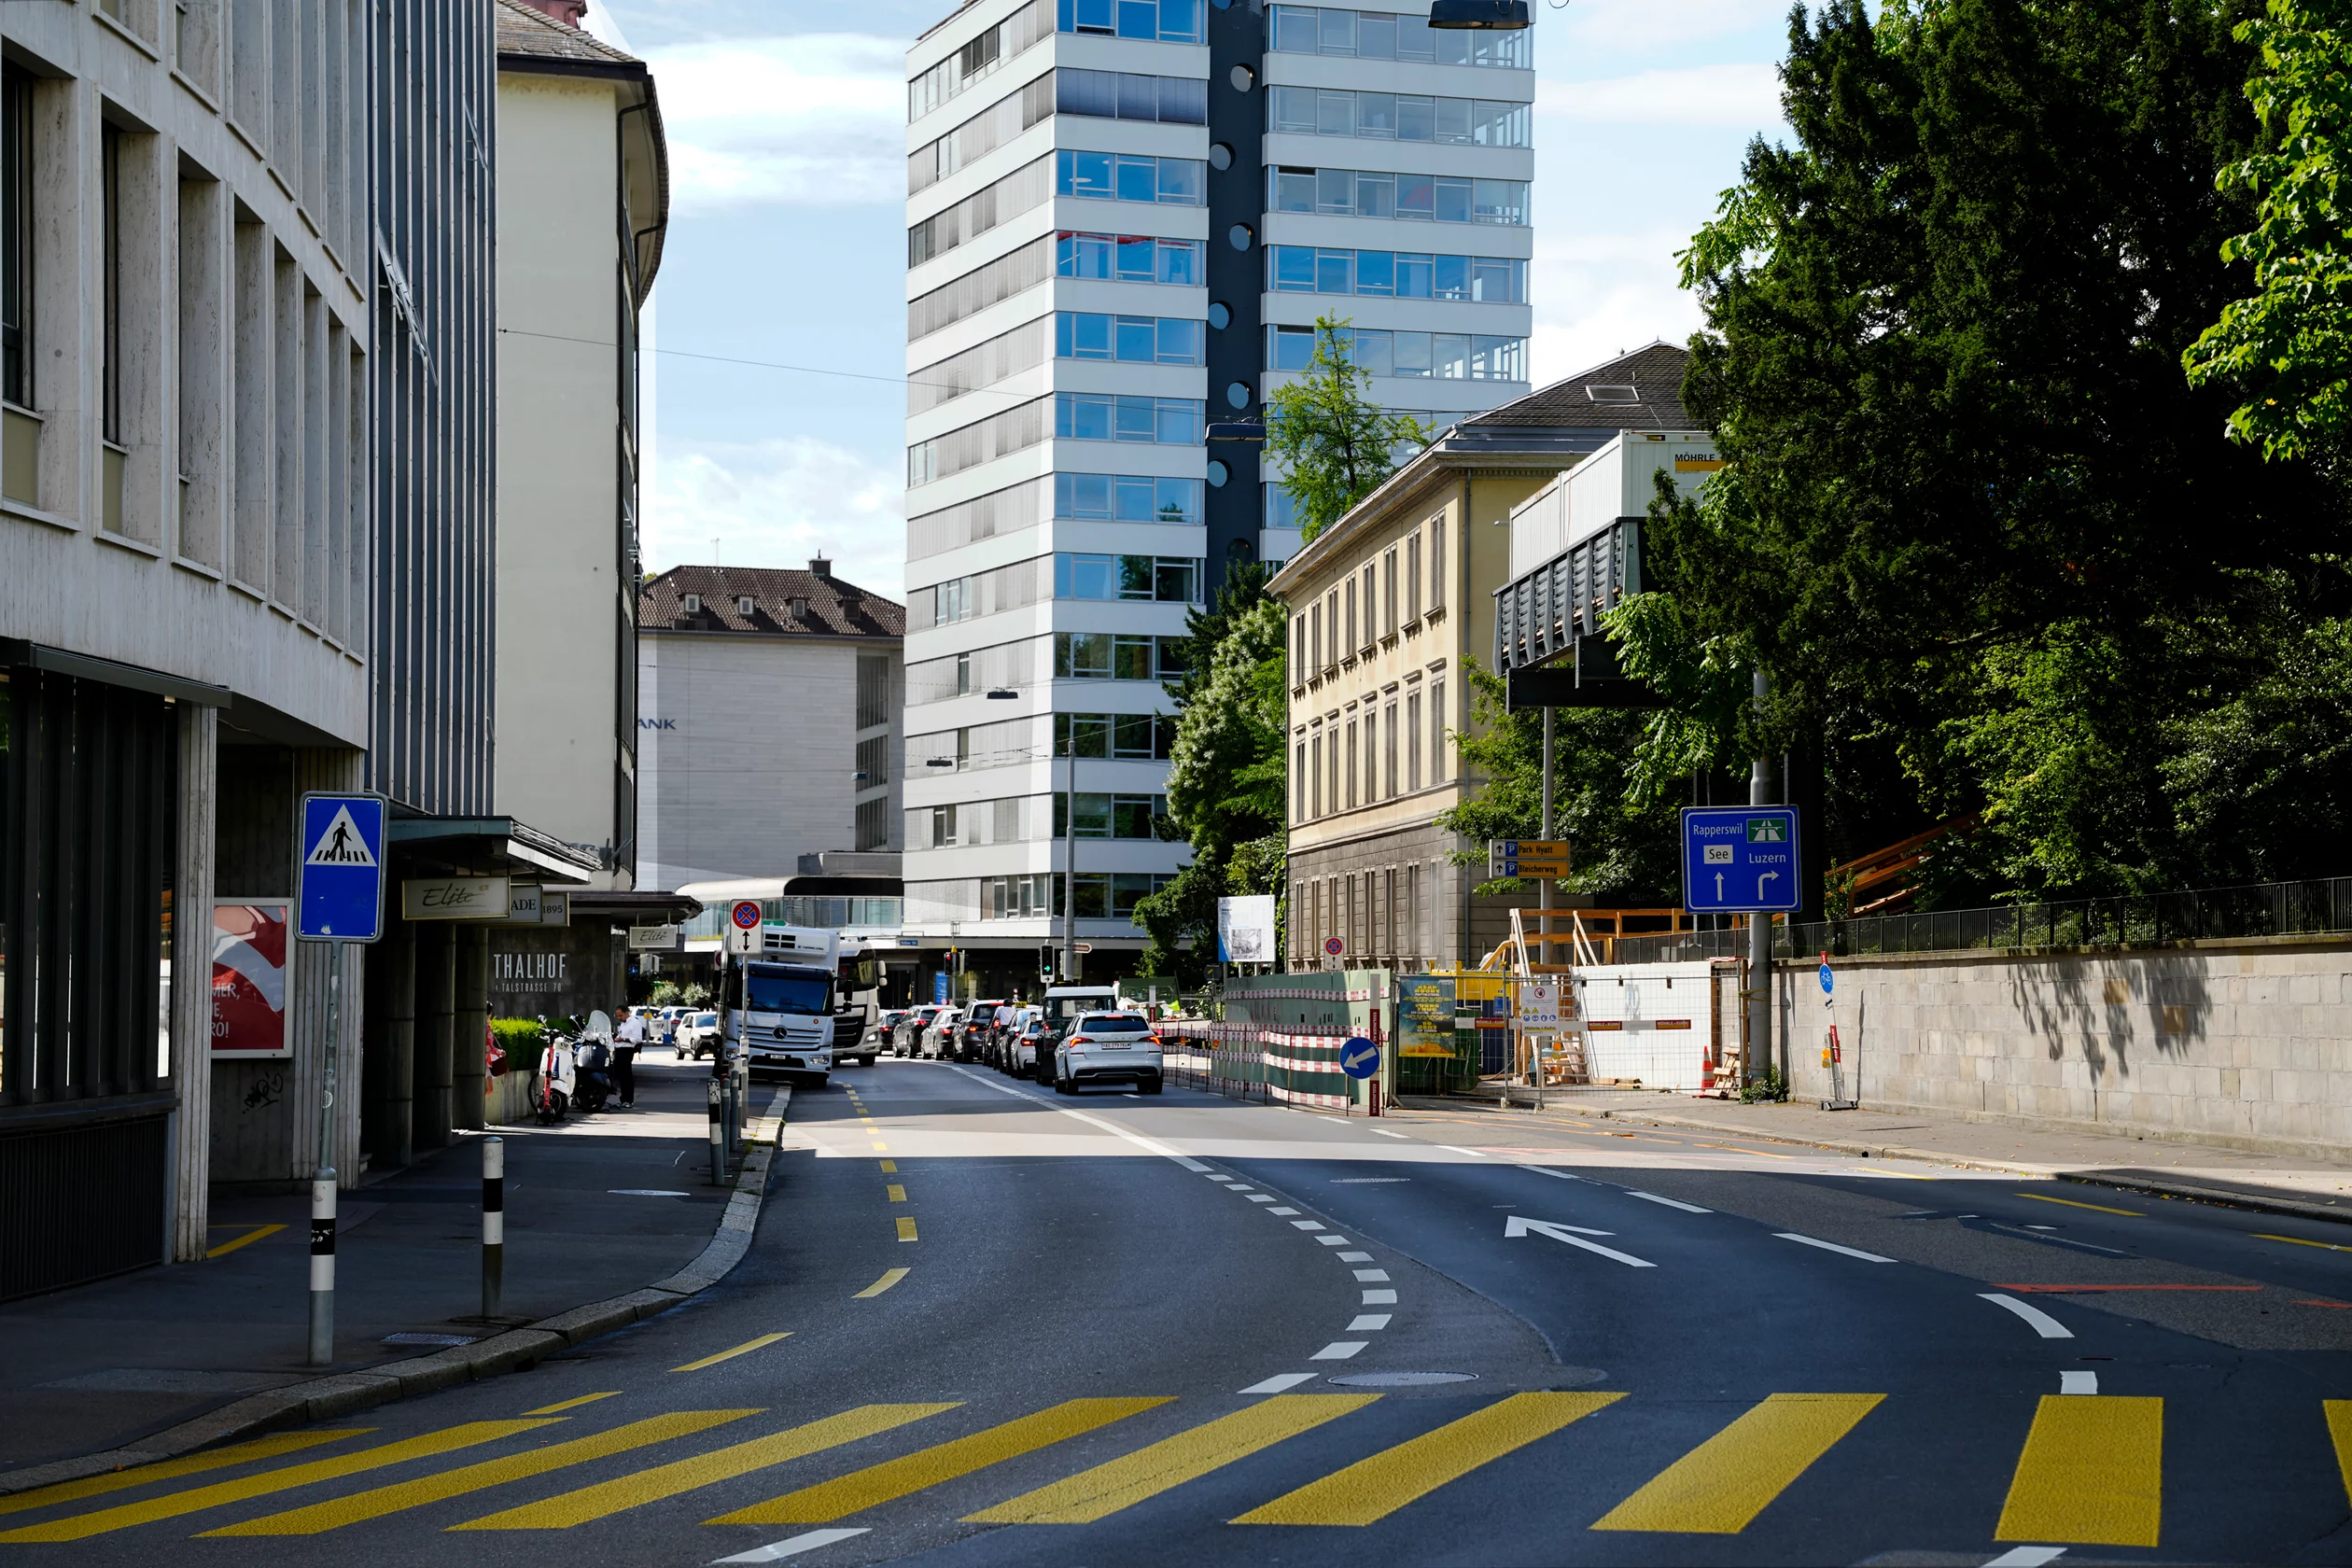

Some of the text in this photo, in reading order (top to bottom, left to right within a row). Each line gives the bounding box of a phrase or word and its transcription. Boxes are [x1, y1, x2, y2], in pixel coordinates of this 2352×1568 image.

[1675, 452, 1715, 462] MÖHRLE
[1693, 823, 1743, 838] Rapperswil
[1518, 845, 1533, 854] Park
[1536, 845, 1553, 855] Hyatt
[1709, 848, 1729, 860] See
[1749, 853, 1786, 864] Luzern
[1518, 865, 1557, 875] Bleicherweg
[422, 883, 484, 907] Elite
[511, 899, 537, 911] ADE
[543, 905, 563, 914] 1895
[640, 930, 667, 941] Elite
[494, 953, 566, 979] THALHOF
[501, 982, 562, 993] TALSTRASSE 70
